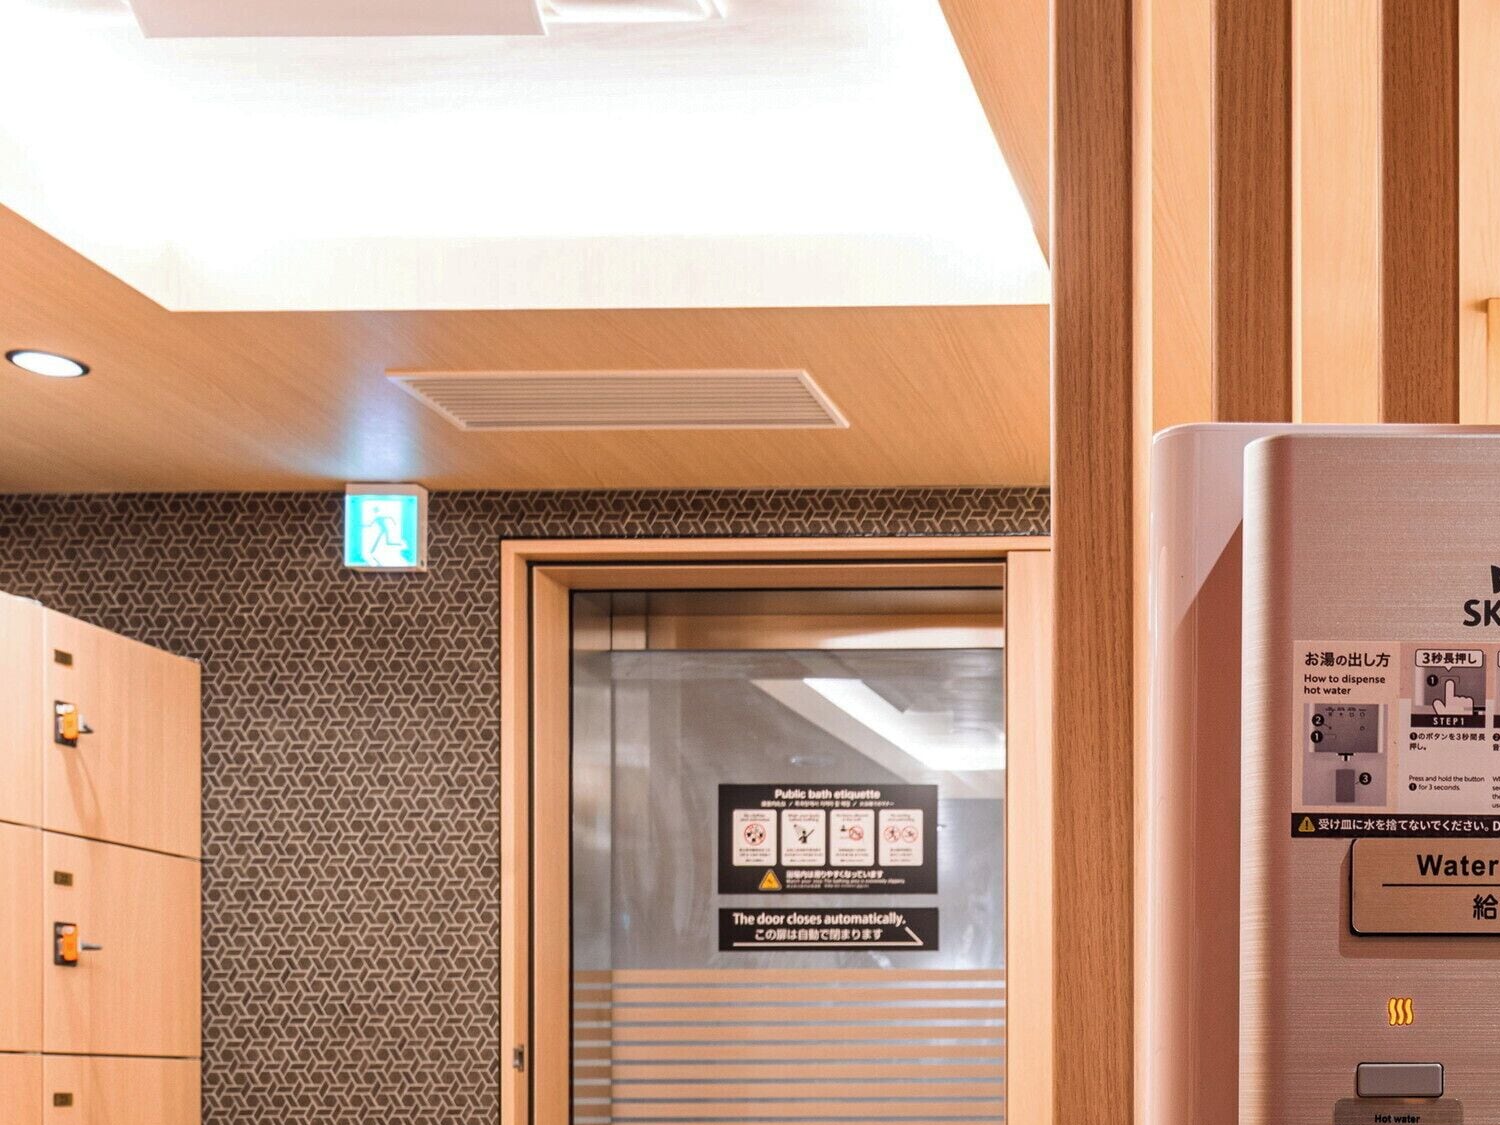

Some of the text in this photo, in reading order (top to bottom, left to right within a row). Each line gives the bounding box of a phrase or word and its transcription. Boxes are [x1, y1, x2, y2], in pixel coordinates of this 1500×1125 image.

[1304, 651, 1391, 667] お湯の出し方
[1422, 652, 1477, 665] 3秒長押し
[1304, 674, 1386, 686] How to dispense
[1303, 685, 1352, 695] hot water
[1432, 717, 1466, 726] STEP1
[1409, 774, 1425, 782] Press
[774, 788, 881, 802] Public bath etiquette
[1318, 818, 1490, 832] 受け皿に水を捨てないでください。
[1416, 853, 1499, 877] Water
[732, 912, 907, 927] The door closes automatically.
[1374, 1114, 1421, 1124] Hot water
